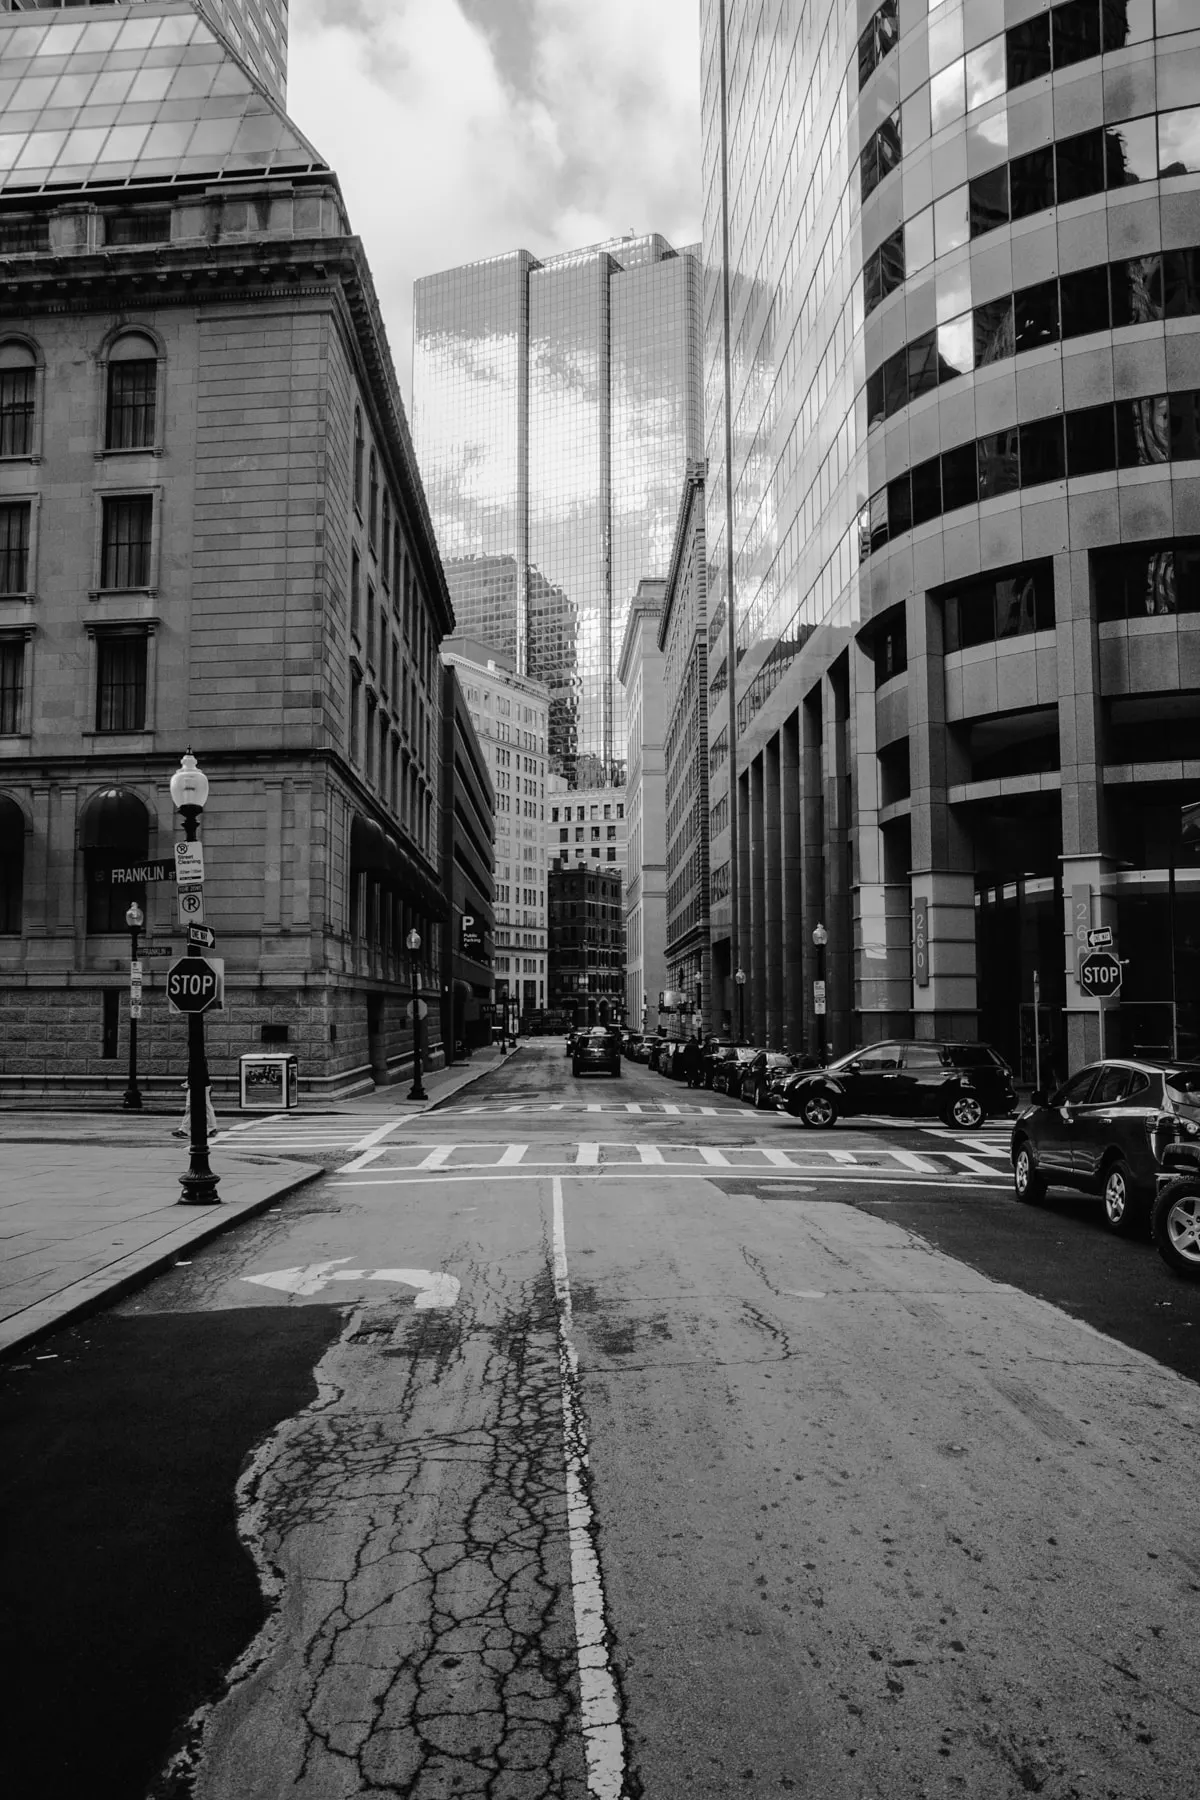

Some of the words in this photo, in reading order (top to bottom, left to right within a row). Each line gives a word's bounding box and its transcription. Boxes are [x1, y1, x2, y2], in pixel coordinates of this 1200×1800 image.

[111, 866, 164, 884] FRANKLIN
[462, 916, 475, 931] P
[916, 914, 924, 968] 260
[1084, 966, 1118, 984] STOP
[170, 974, 213, 995] STOP
